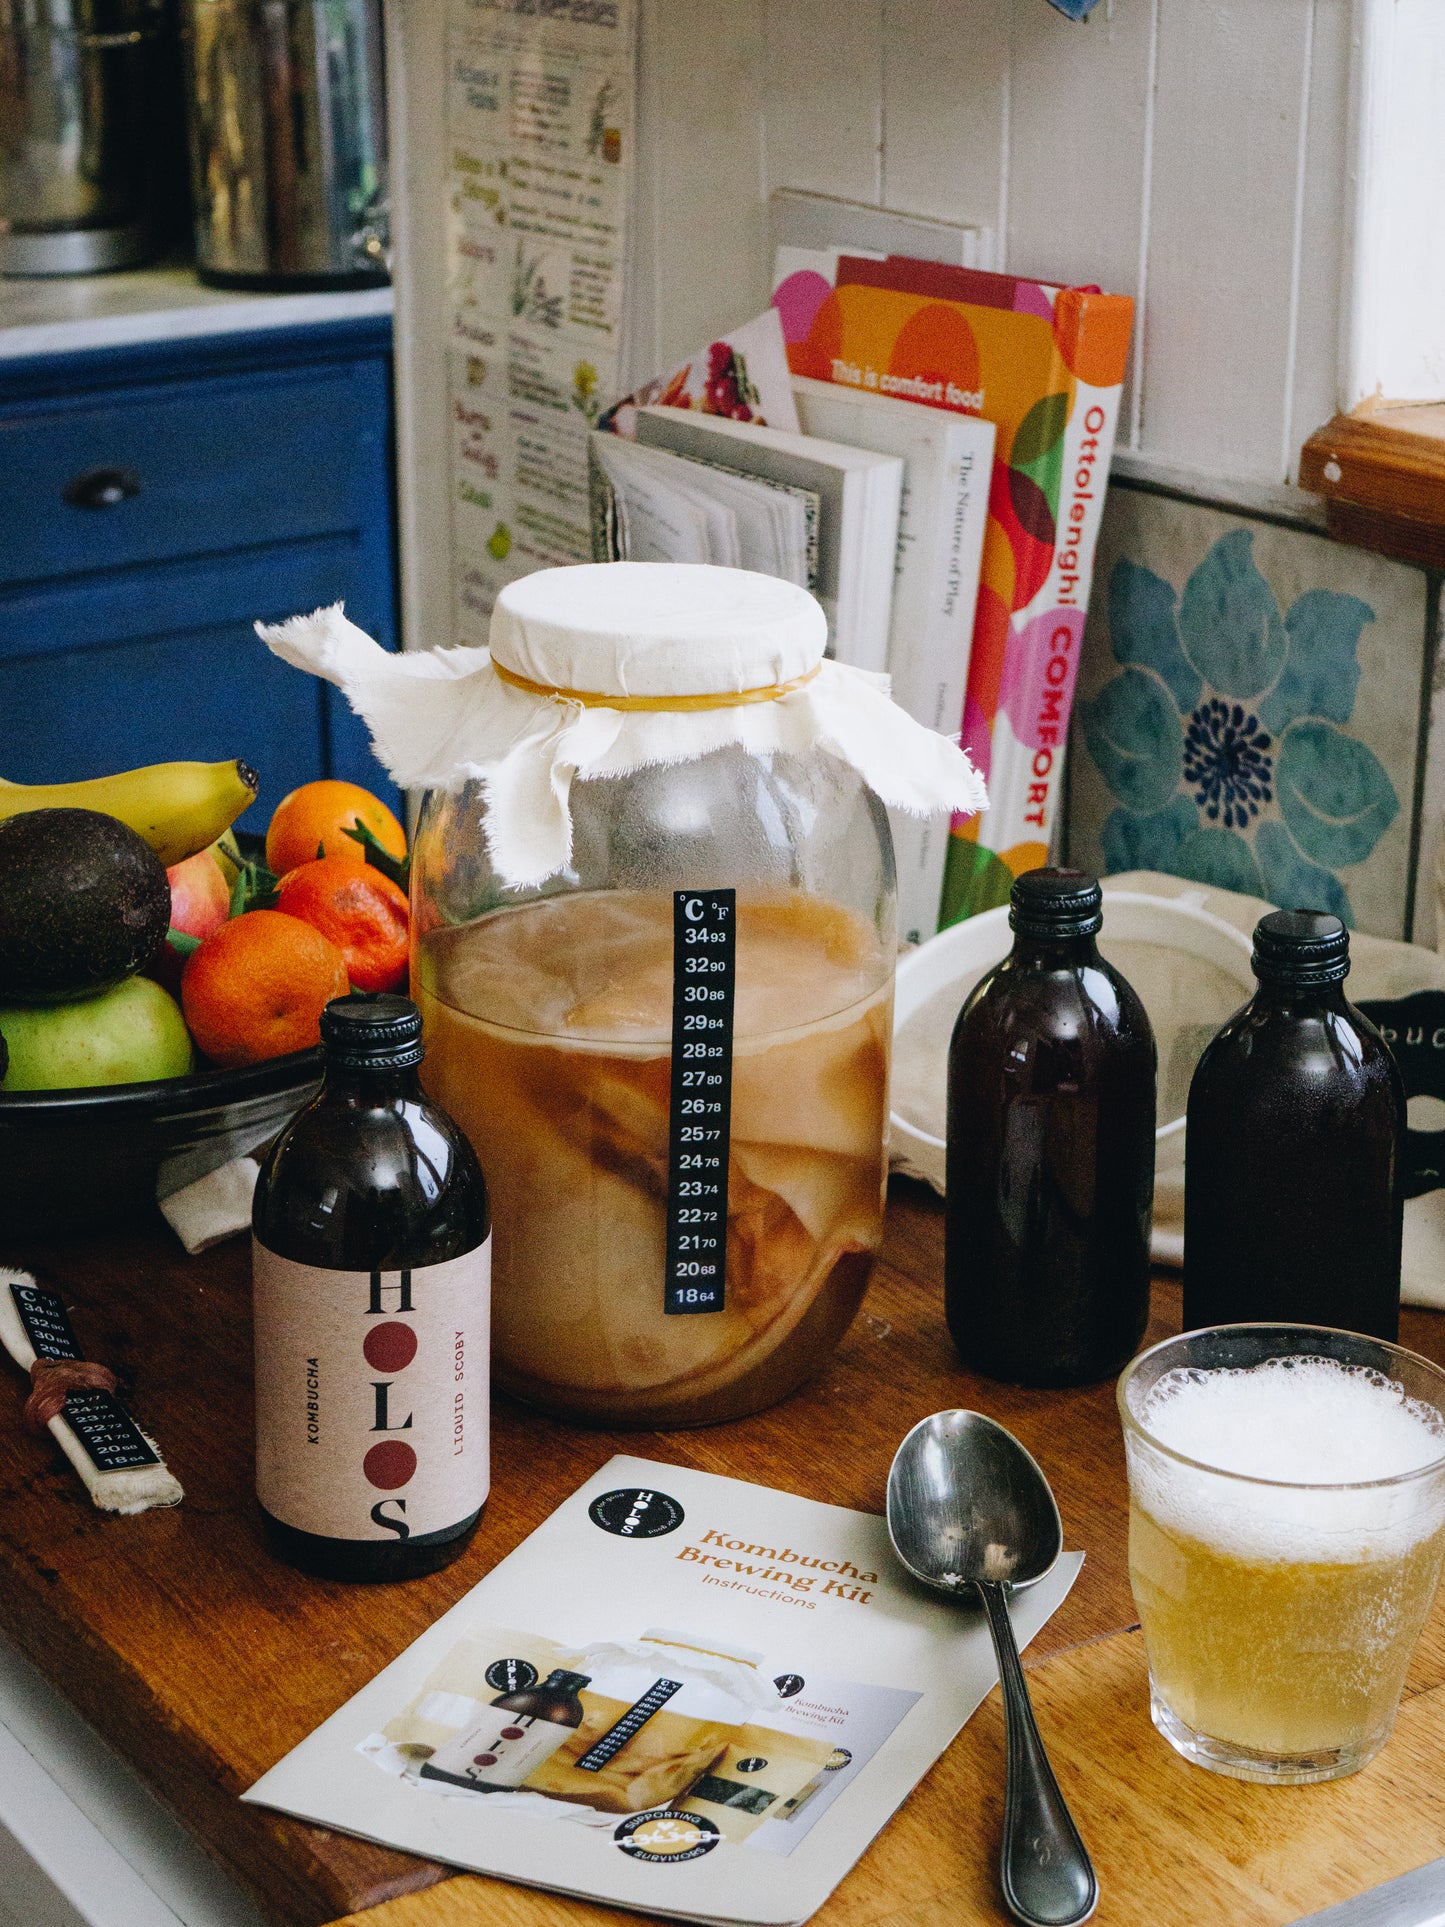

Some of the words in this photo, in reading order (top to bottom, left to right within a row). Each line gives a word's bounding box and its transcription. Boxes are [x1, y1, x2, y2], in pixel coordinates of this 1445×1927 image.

[831, 359, 862, 385] This
[865, 365, 878, 388] is
[880, 374, 942, 401] comfort
[945, 382, 985, 410] food
[960, 452, 974, 486] The
[1056, 405, 1106, 605] Ottolenghi
[952, 491, 970, 553] Nature
[950, 557, 961, 577] of
[943, 580, 961, 617] Play
[1024, 625, 1073, 829] COMFORT
[685, 928, 709, 943] 34
[711, 933, 726, 942] 93
[685, 957, 709, 973] 32
[710, 962, 726, 971] 90
[684, 986, 709, 1001] 30
[710, 990, 725, 1000] 86
[683, 1015, 708, 1030] 29
[709, 1019, 724, 1028] 84
[683, 1043, 707, 1058] 28
[708, 1047, 723, 1056] 82
[682, 1071, 706, 1086] 27
[707, 1075, 722, 1084] 80
[681, 1099, 705, 1113] 26
[707, 1103, 721, 1112] 78
[680, 1127, 704, 1141] 25
[706, 1130, 720, 1140] 77
[679, 1155, 703, 1168] 24
[705, 1158, 720, 1167] 76
[679, 1182, 702, 1195] 23
[704, 1185, 718, 1194] 74
[678, 1209, 702, 1222] 22
[703, 1212, 718, 1221] 72
[678, 1236, 700, 1249] 21
[702, 1239, 717, 1248] 70
[676, 1262, 700, 1276] 20
[701, 1266, 716, 1275] 68
[676, 1289, 698, 1302] 18
[699, 1292, 715, 1301] 64
[454, 1330, 464, 1382] SCOBY
[307, 1357, 319, 1444] KOMBUCHA
[454, 1392, 464, 1456] LIQUID
[700, 1529, 878, 1584] Kombucha
[675, 1546, 818, 1592] Brewing
[820, 1579, 874, 1605] Kit
[701, 1574, 817, 1610] Instructions
[795, 1699, 849, 1716] Kombucha
[625, 1811, 701, 1829] SUPPORTING
[634, 1847, 706, 1862] SURVIVORS
